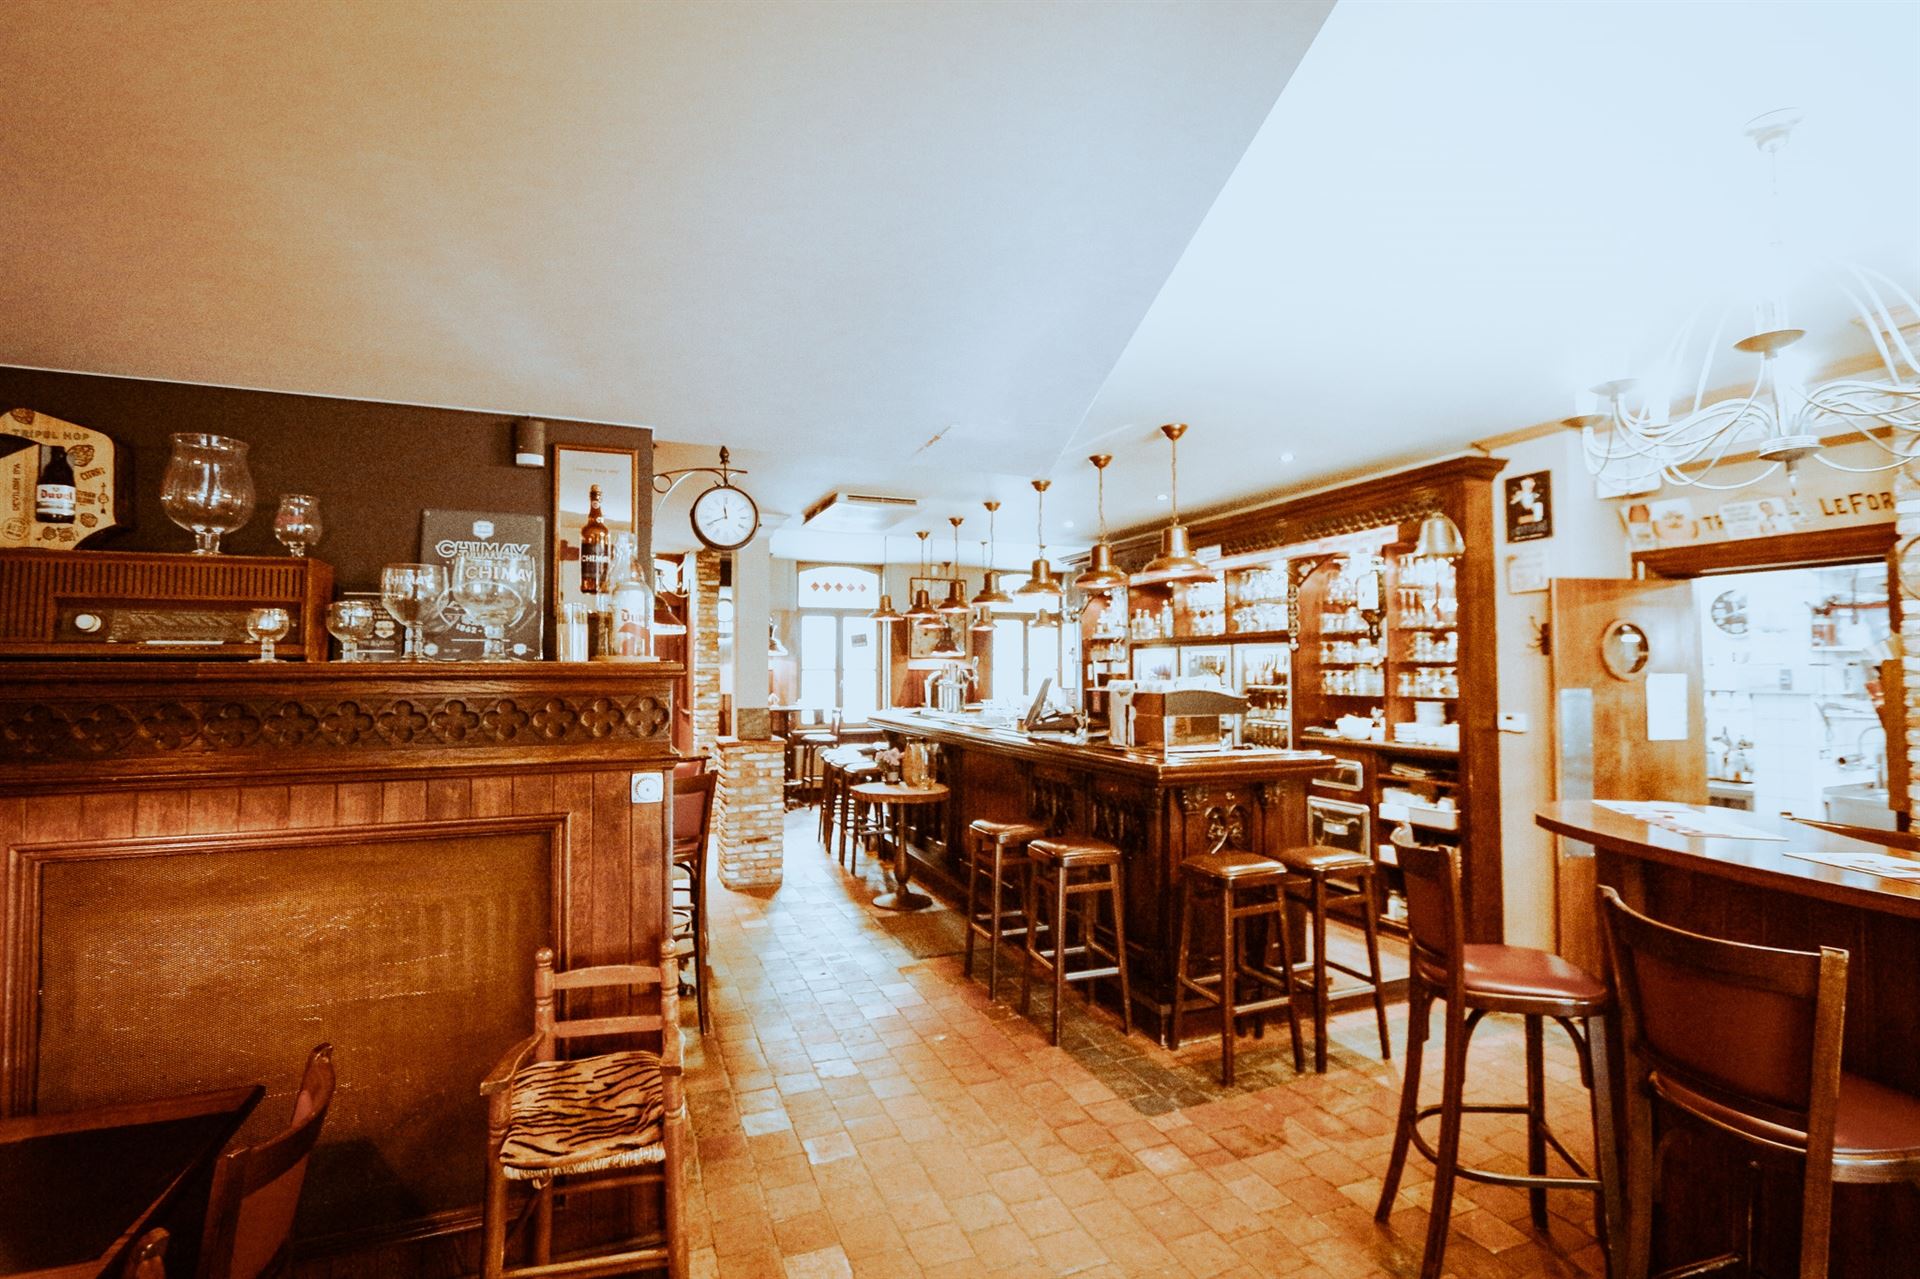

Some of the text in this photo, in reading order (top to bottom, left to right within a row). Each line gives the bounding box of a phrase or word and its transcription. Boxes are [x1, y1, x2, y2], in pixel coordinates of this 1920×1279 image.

[63, 431, 90, 441] HOP
[434, 538, 532, 560] CHIMAY
[465, 565, 533, 583] CHIMAY
[456, 623, 478, 634] 1862
